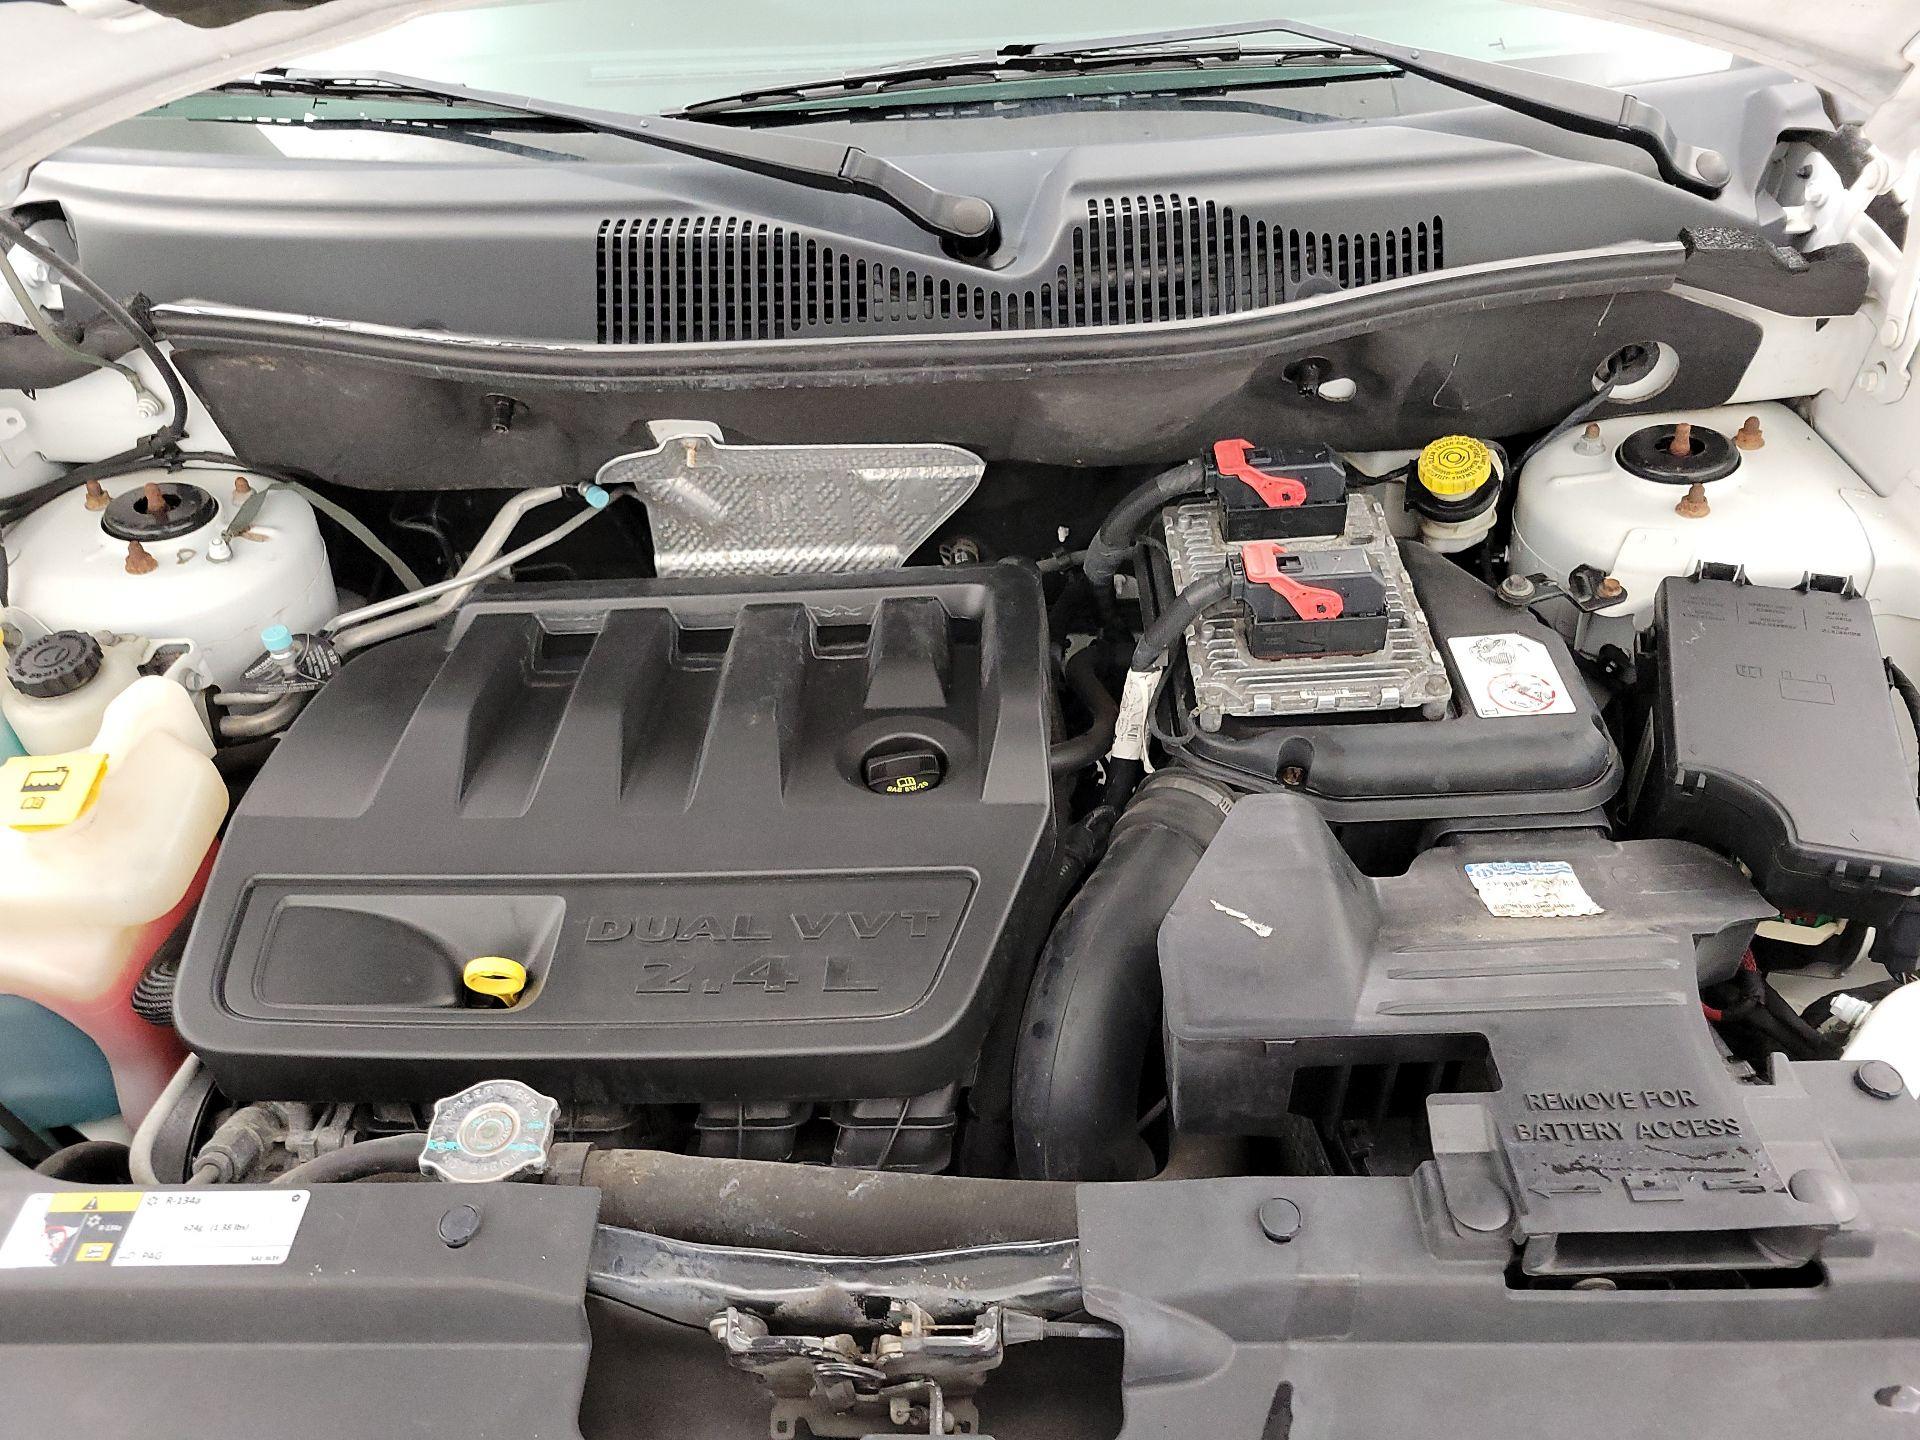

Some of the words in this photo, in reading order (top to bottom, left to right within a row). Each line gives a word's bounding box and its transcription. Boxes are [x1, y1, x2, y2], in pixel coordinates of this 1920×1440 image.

[585, 913, 772, 943] DUAL
[789, 910, 941, 940] VVT
[635, 954, 800, 995] 2.4
[1524, 1091, 1638, 1111] REMOVE
[1640, 1089, 1699, 1109] FOR
[1514, 1121, 1625, 1141] BATTERY
[1636, 1117, 1741, 1140] ACCESS
[166, 1196, 201, 1205] R-134a
